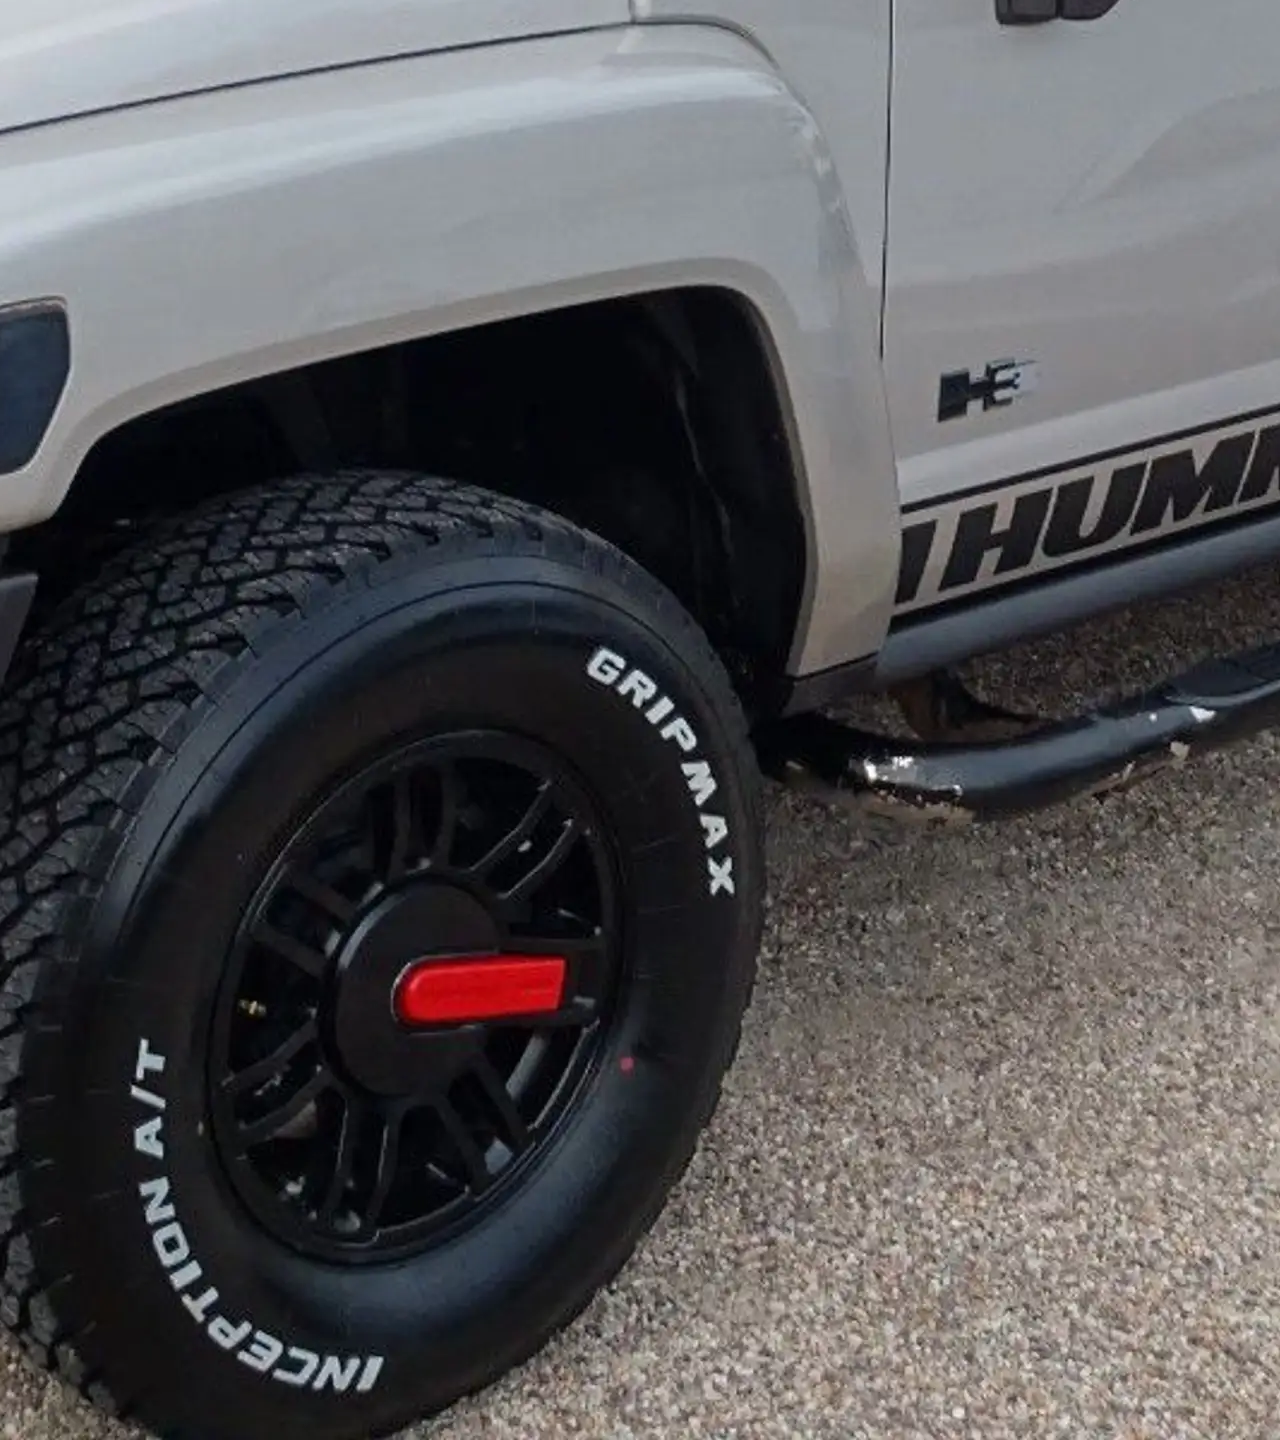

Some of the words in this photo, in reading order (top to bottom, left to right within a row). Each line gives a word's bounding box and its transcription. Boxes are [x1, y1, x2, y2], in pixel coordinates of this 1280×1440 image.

[586, 646, 736, 896] GRIPMAX
[129, 1037, 168, 1160] A/T
[138, 1175, 385, 1394] INCEPTION
